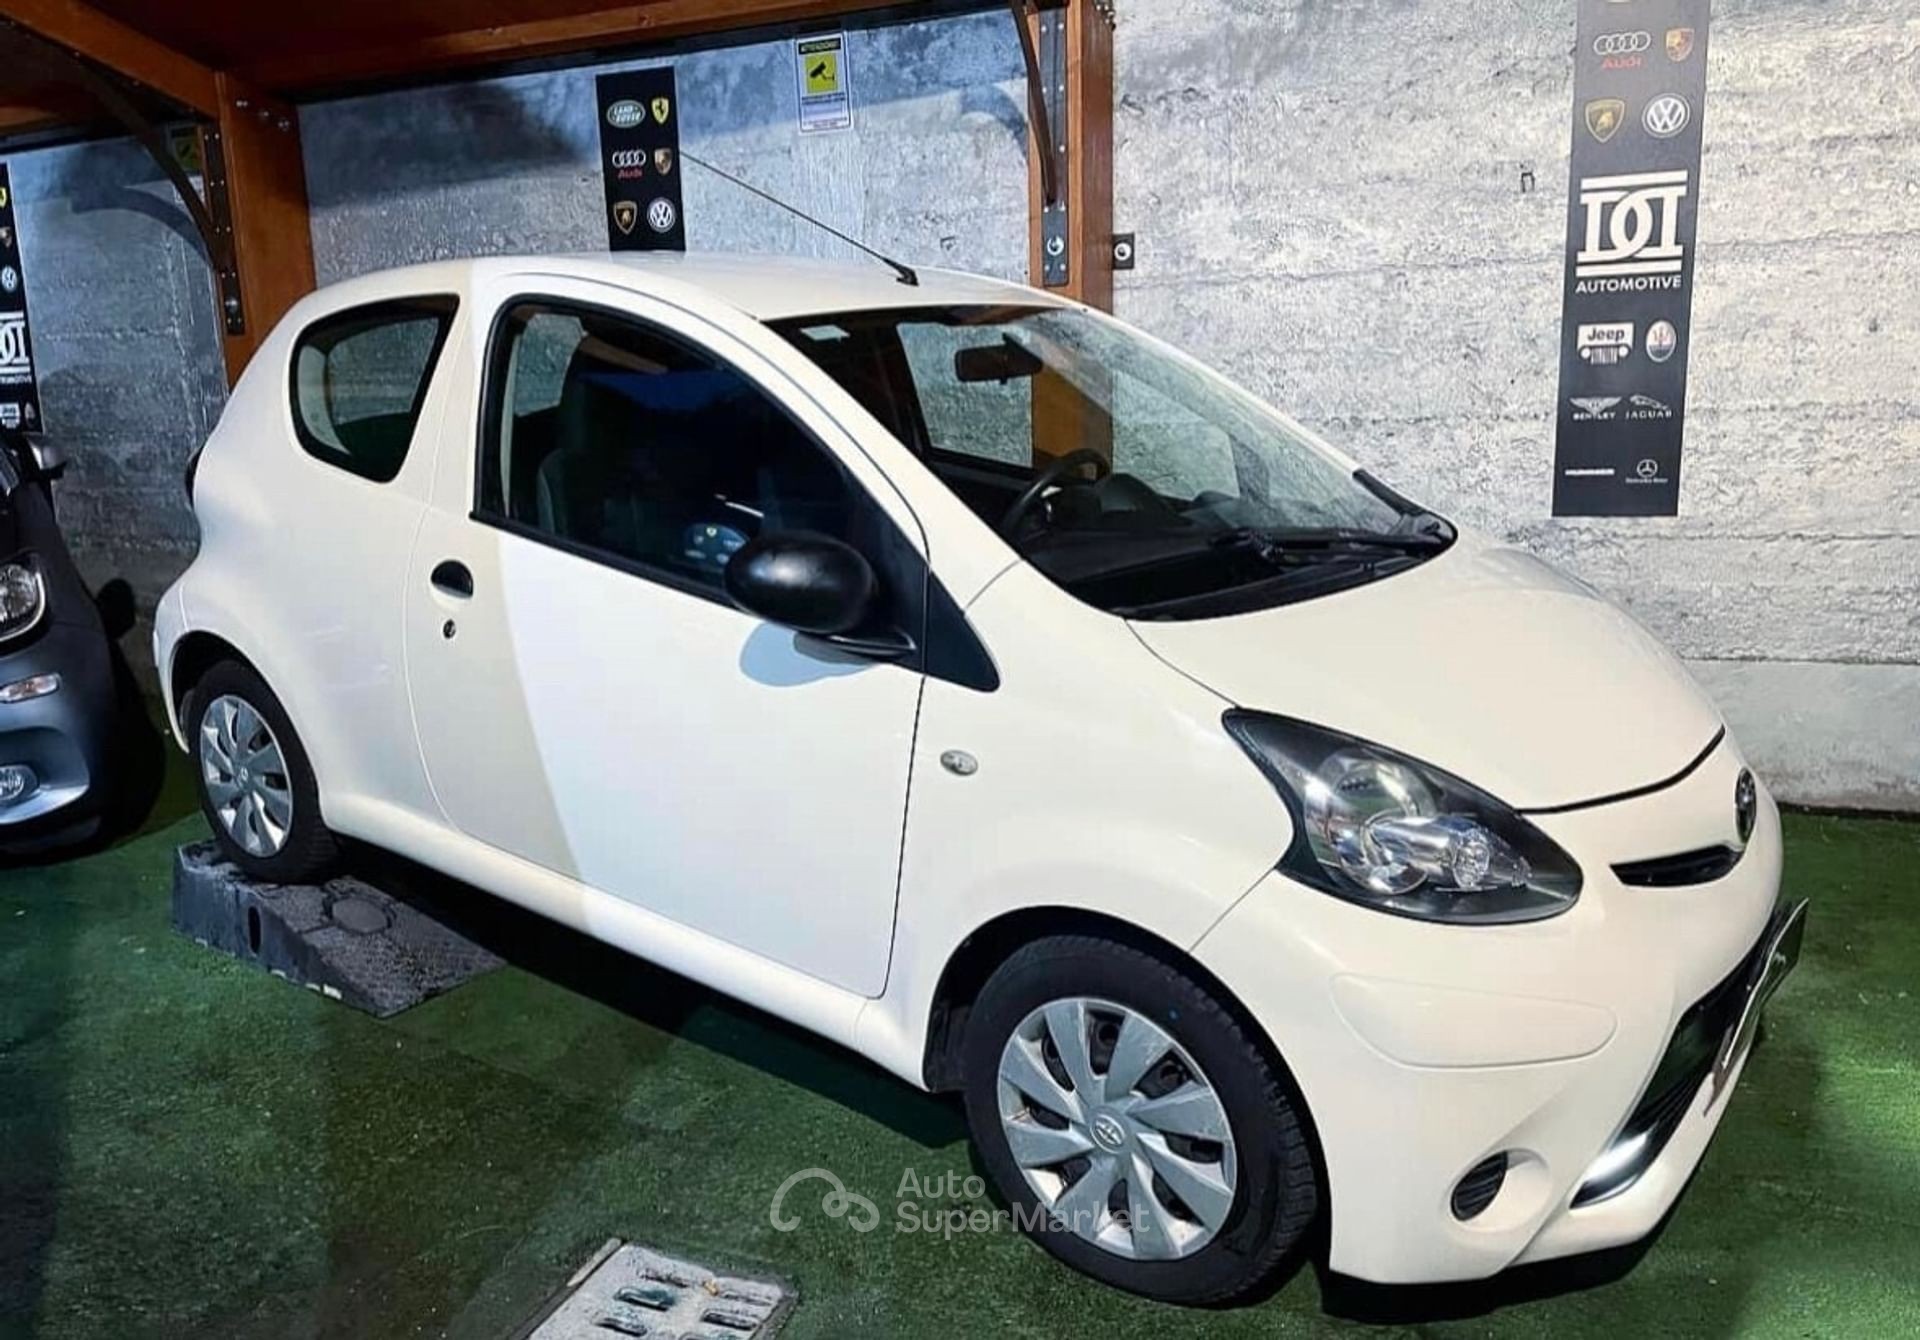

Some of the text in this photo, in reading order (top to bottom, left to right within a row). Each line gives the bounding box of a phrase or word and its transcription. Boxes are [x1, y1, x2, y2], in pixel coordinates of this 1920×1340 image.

[1602, 57, 1642, 69] Audi
[1575, 275, 1682, 294] AUTOMOTIVE
[1587, 327, 1625, 342] Jeep
[1625, 410, 1672, 419] JAGUAR
